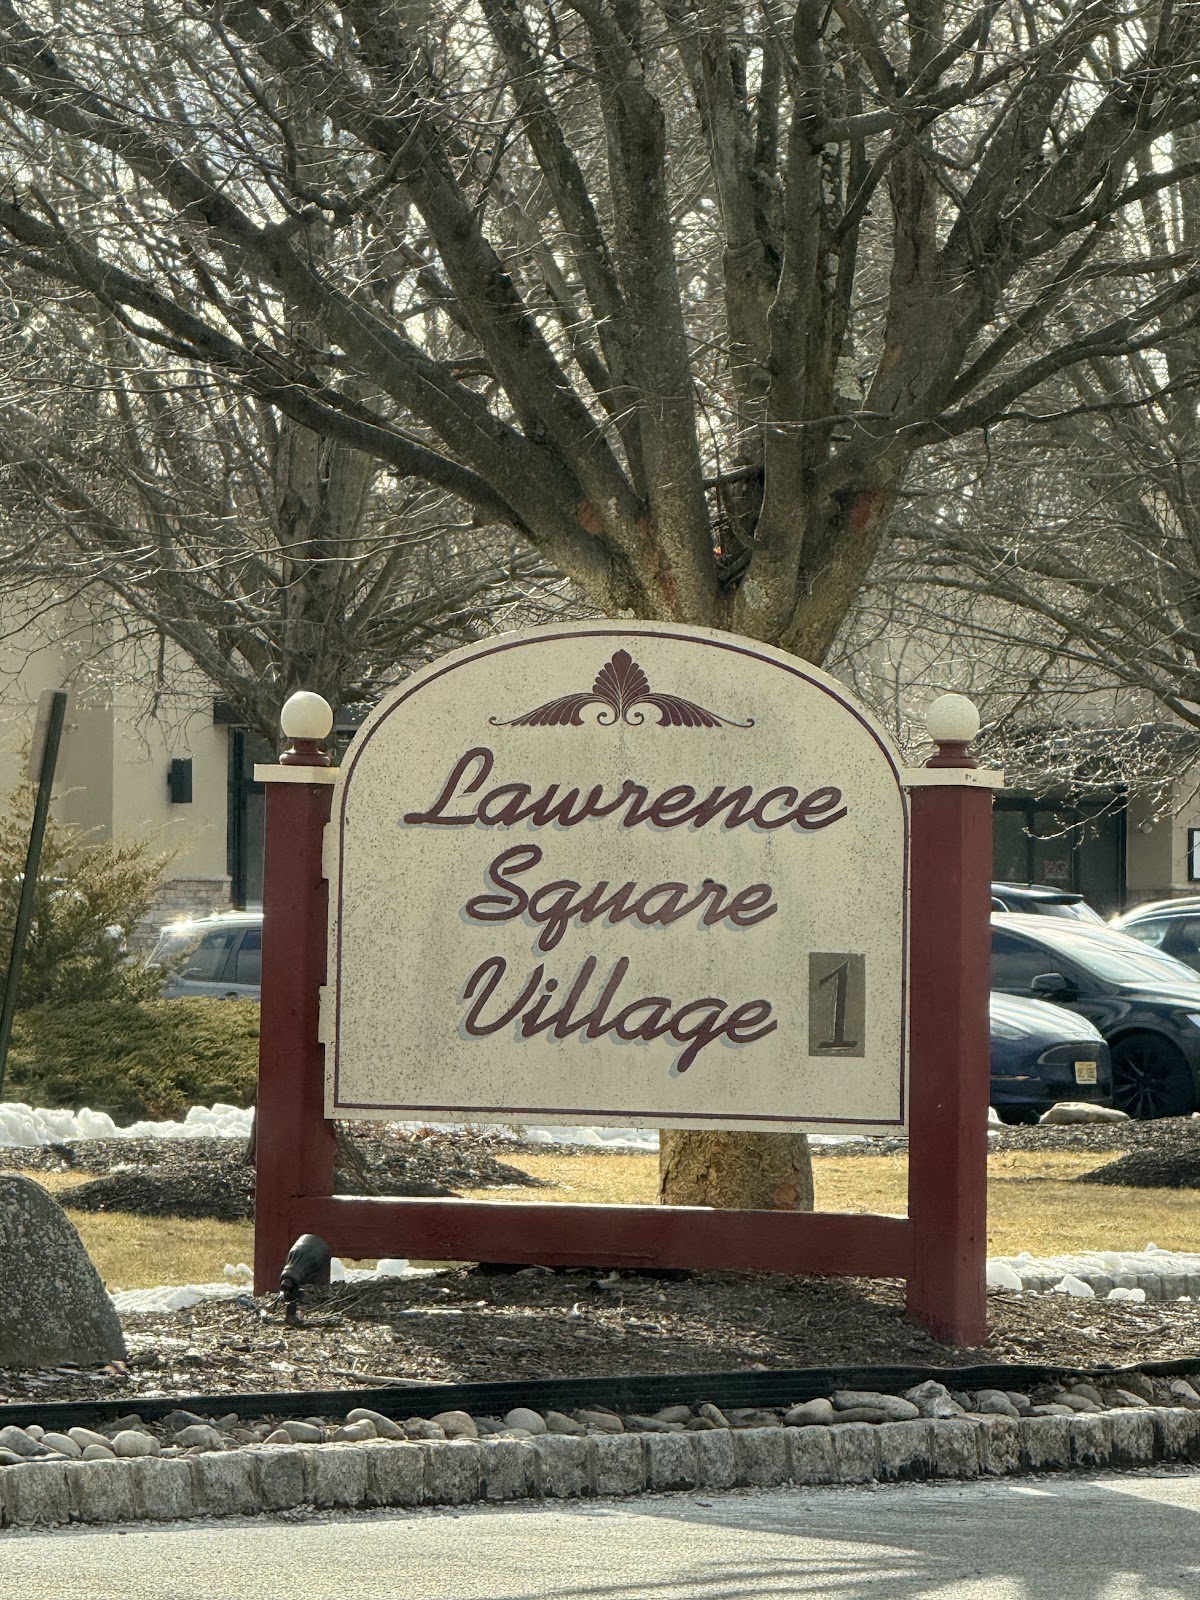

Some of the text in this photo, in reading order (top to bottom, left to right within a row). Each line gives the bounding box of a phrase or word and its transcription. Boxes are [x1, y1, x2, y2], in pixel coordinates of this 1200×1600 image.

[404, 747, 848, 830] Lawrence
[466, 844, 778, 951] Square
[463, 955, 778, 1073] Village
[817, 959, 860, 1050] 1
